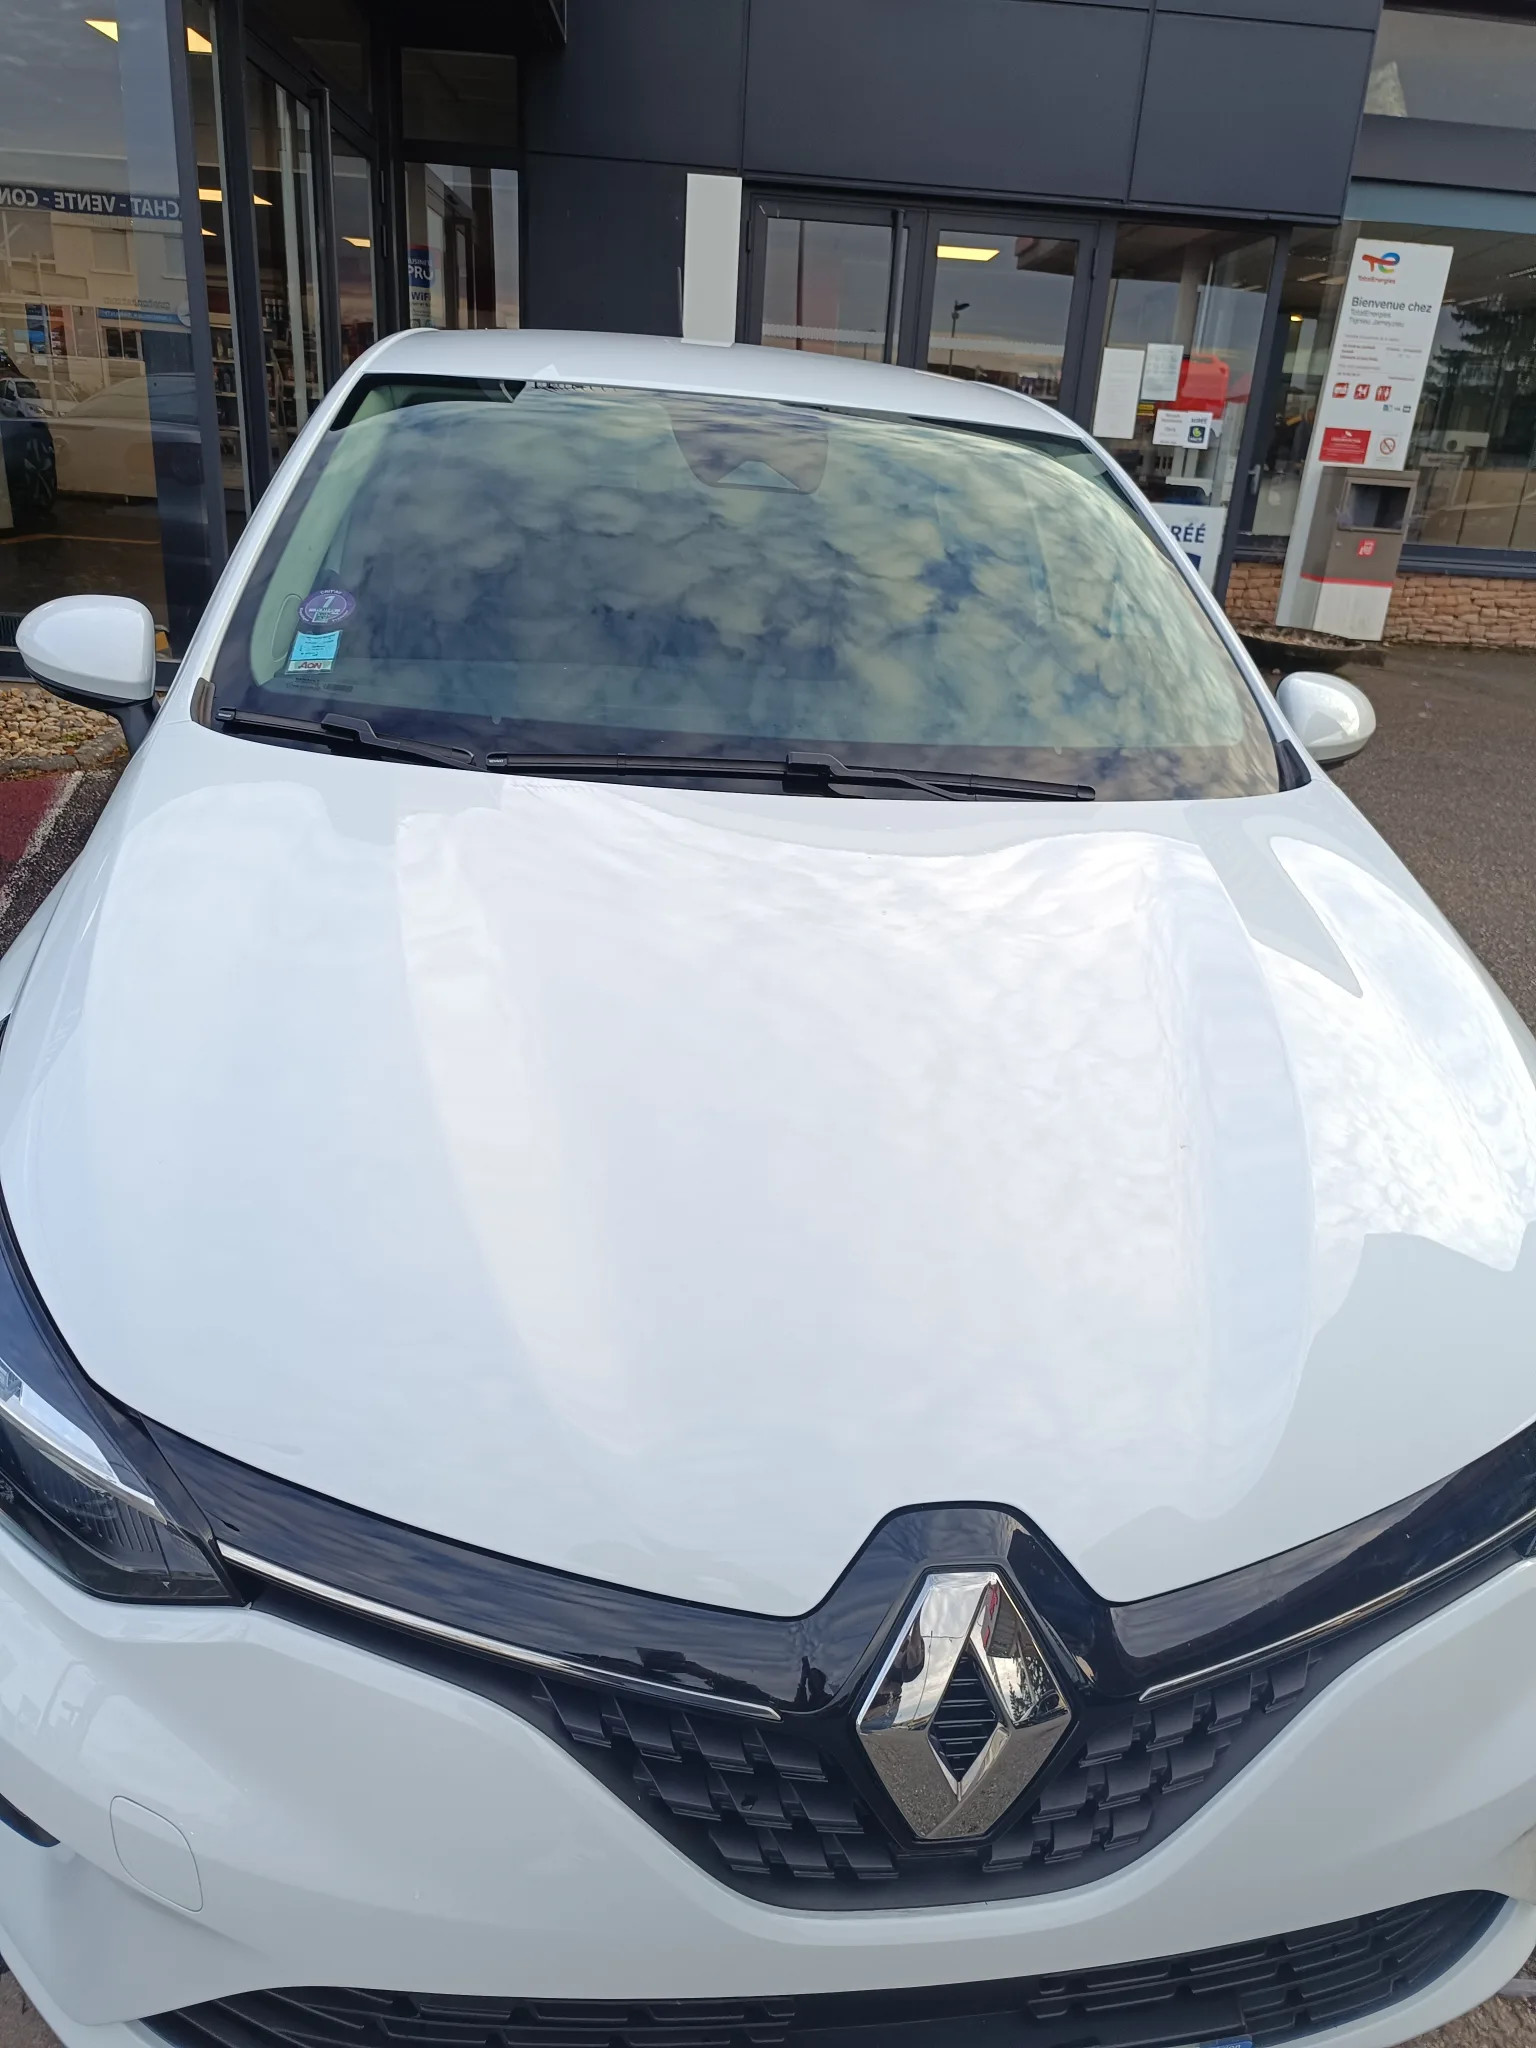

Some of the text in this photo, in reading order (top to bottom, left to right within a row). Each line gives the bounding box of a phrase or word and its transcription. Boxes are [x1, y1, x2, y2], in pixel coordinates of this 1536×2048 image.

[1351, 296, 1432, 313] Bienvenue chez
[1167, 522, 1207, 544] RÉÉ
